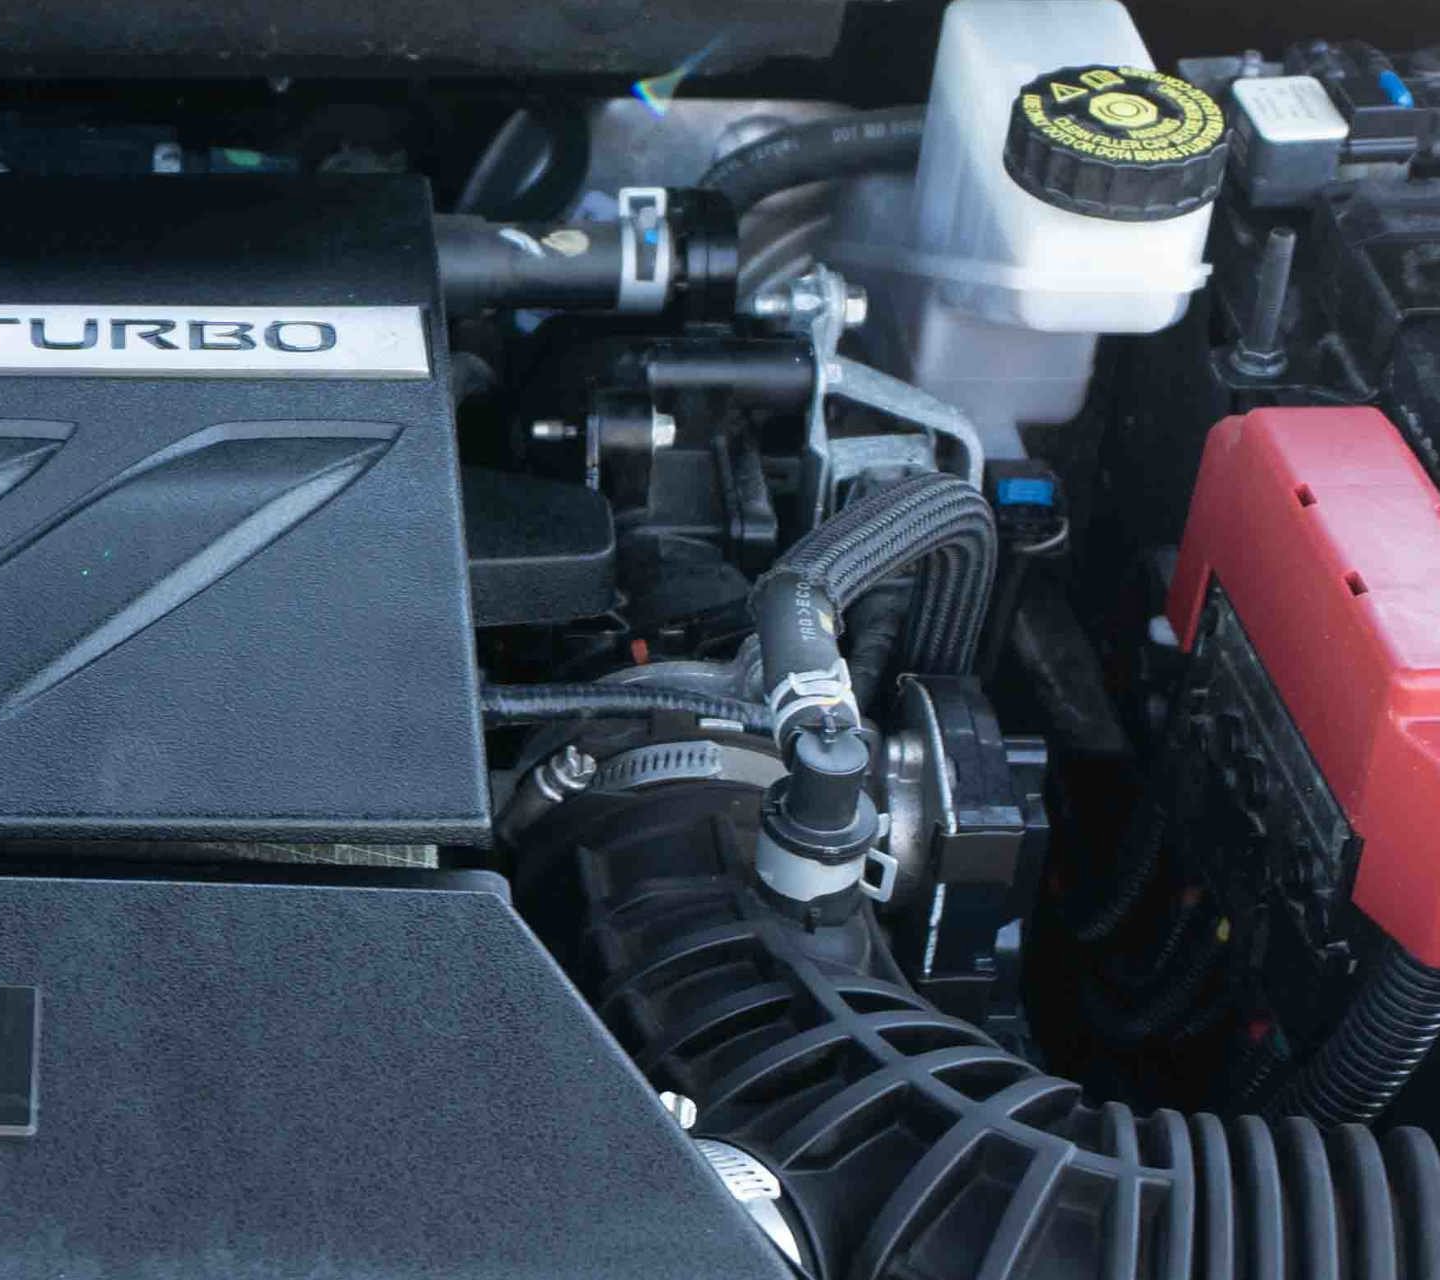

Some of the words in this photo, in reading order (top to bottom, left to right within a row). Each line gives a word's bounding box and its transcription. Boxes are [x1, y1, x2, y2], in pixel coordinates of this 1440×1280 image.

[1054, 117, 1093, 140] CLEAN
[1092, 135, 1142, 149] FILLER
[1074, 140, 1096, 153] OR
[1095, 147, 1134, 160] DOT4
[1134, 147, 1184, 161] BRAKE
